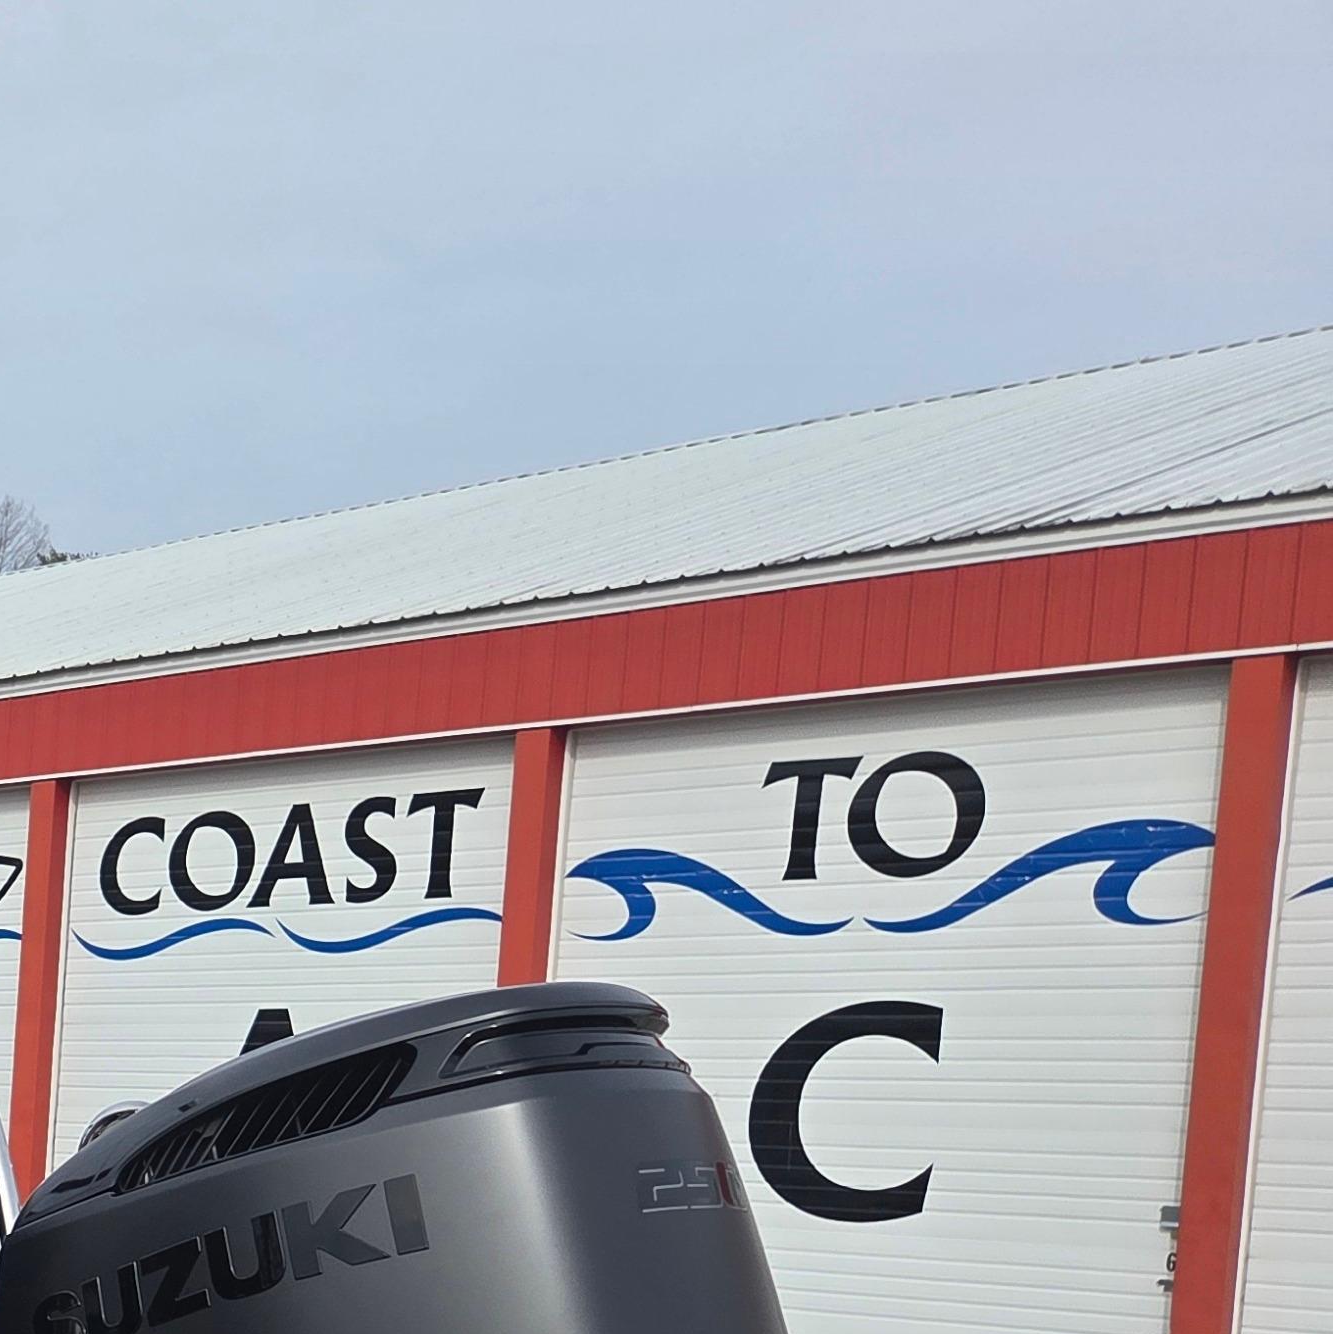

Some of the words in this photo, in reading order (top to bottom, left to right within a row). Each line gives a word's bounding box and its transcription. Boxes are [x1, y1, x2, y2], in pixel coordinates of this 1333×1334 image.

[99, 788, 485, 915] COAST
[761, 750, 986, 878] TO
[748, 1000, 944, 1223] C
[1166, 1252, 1178, 1273] 6
